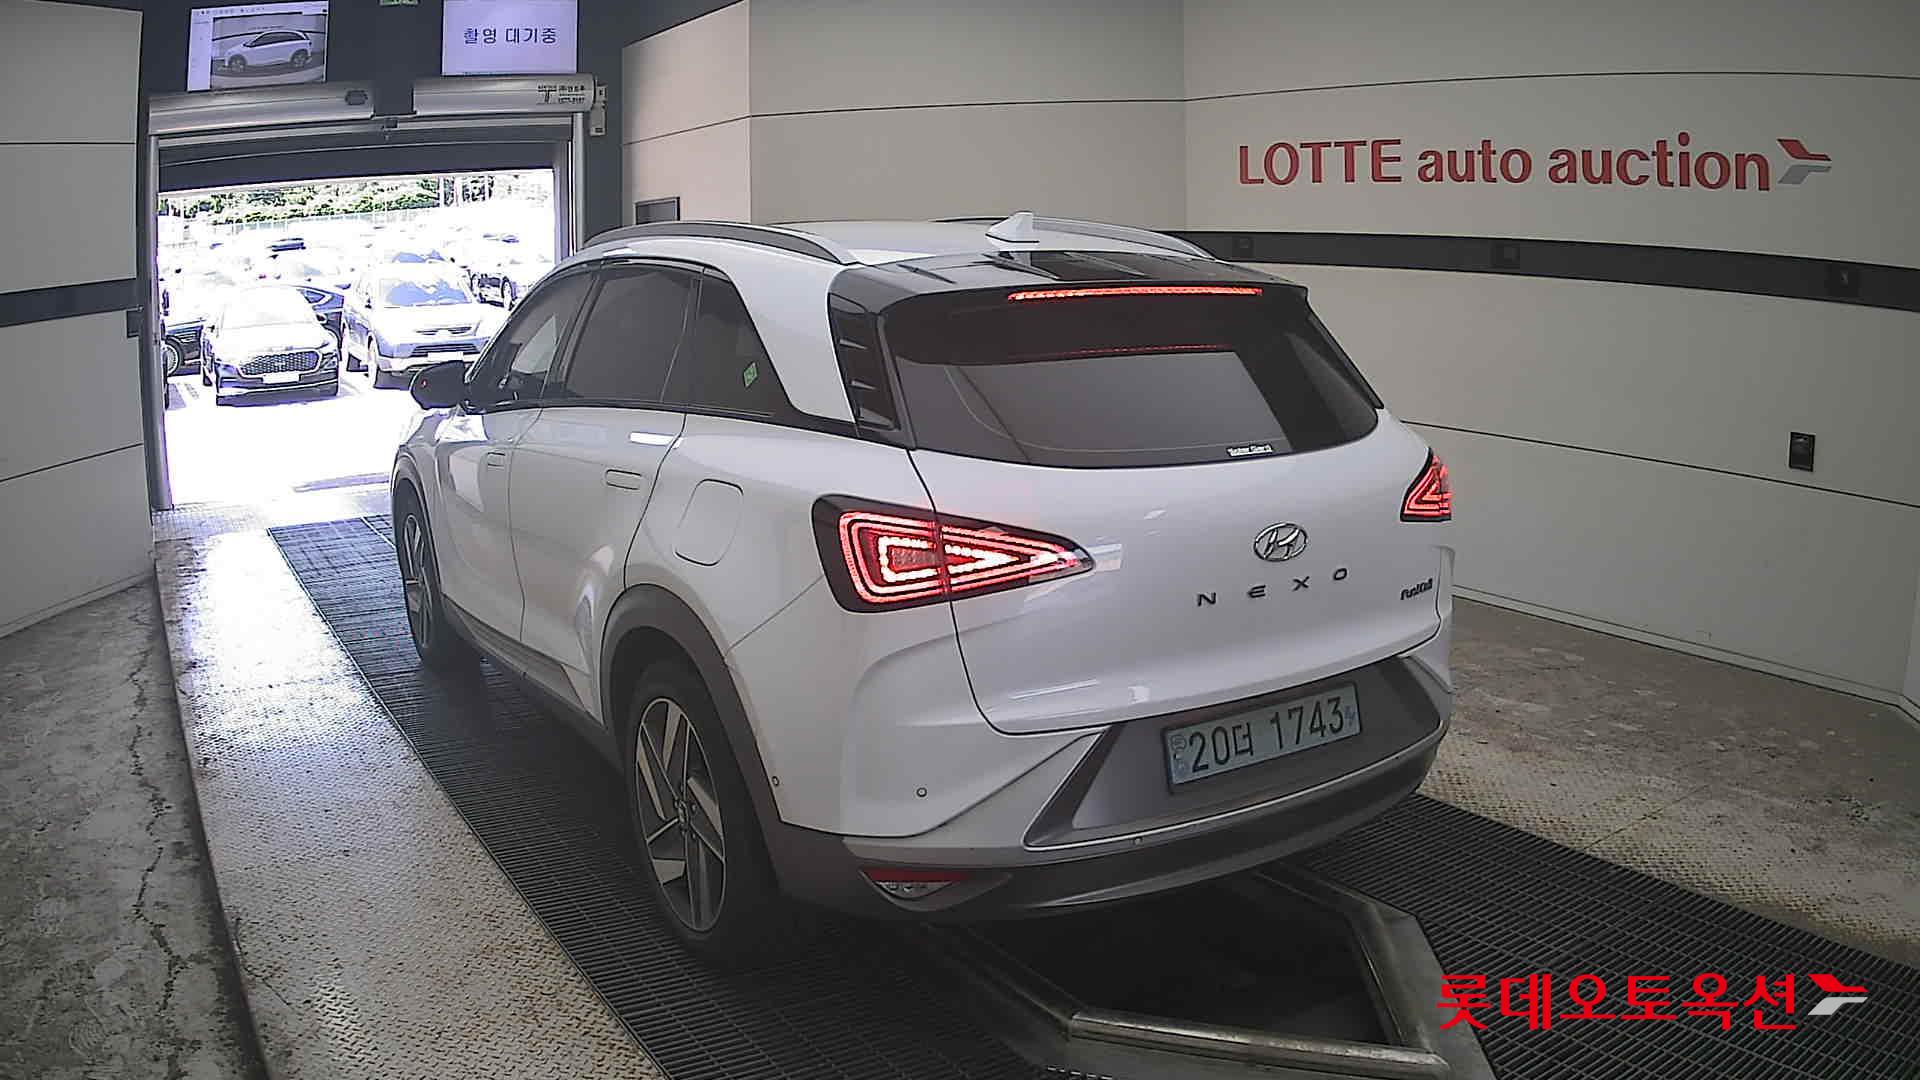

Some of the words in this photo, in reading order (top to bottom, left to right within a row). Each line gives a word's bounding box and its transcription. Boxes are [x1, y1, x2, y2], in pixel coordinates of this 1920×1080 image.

[463, 27, 498, 45] 촬영
[505, 27, 557, 45] 대기중
[1238, 138, 1403, 186] LOTTE
[1416, 139, 1533, 184] auto
[1548, 131, 1771, 192] auction
[1196, 567, 1349, 607] NEXO
[1269, 696, 1345, 750] 1743
